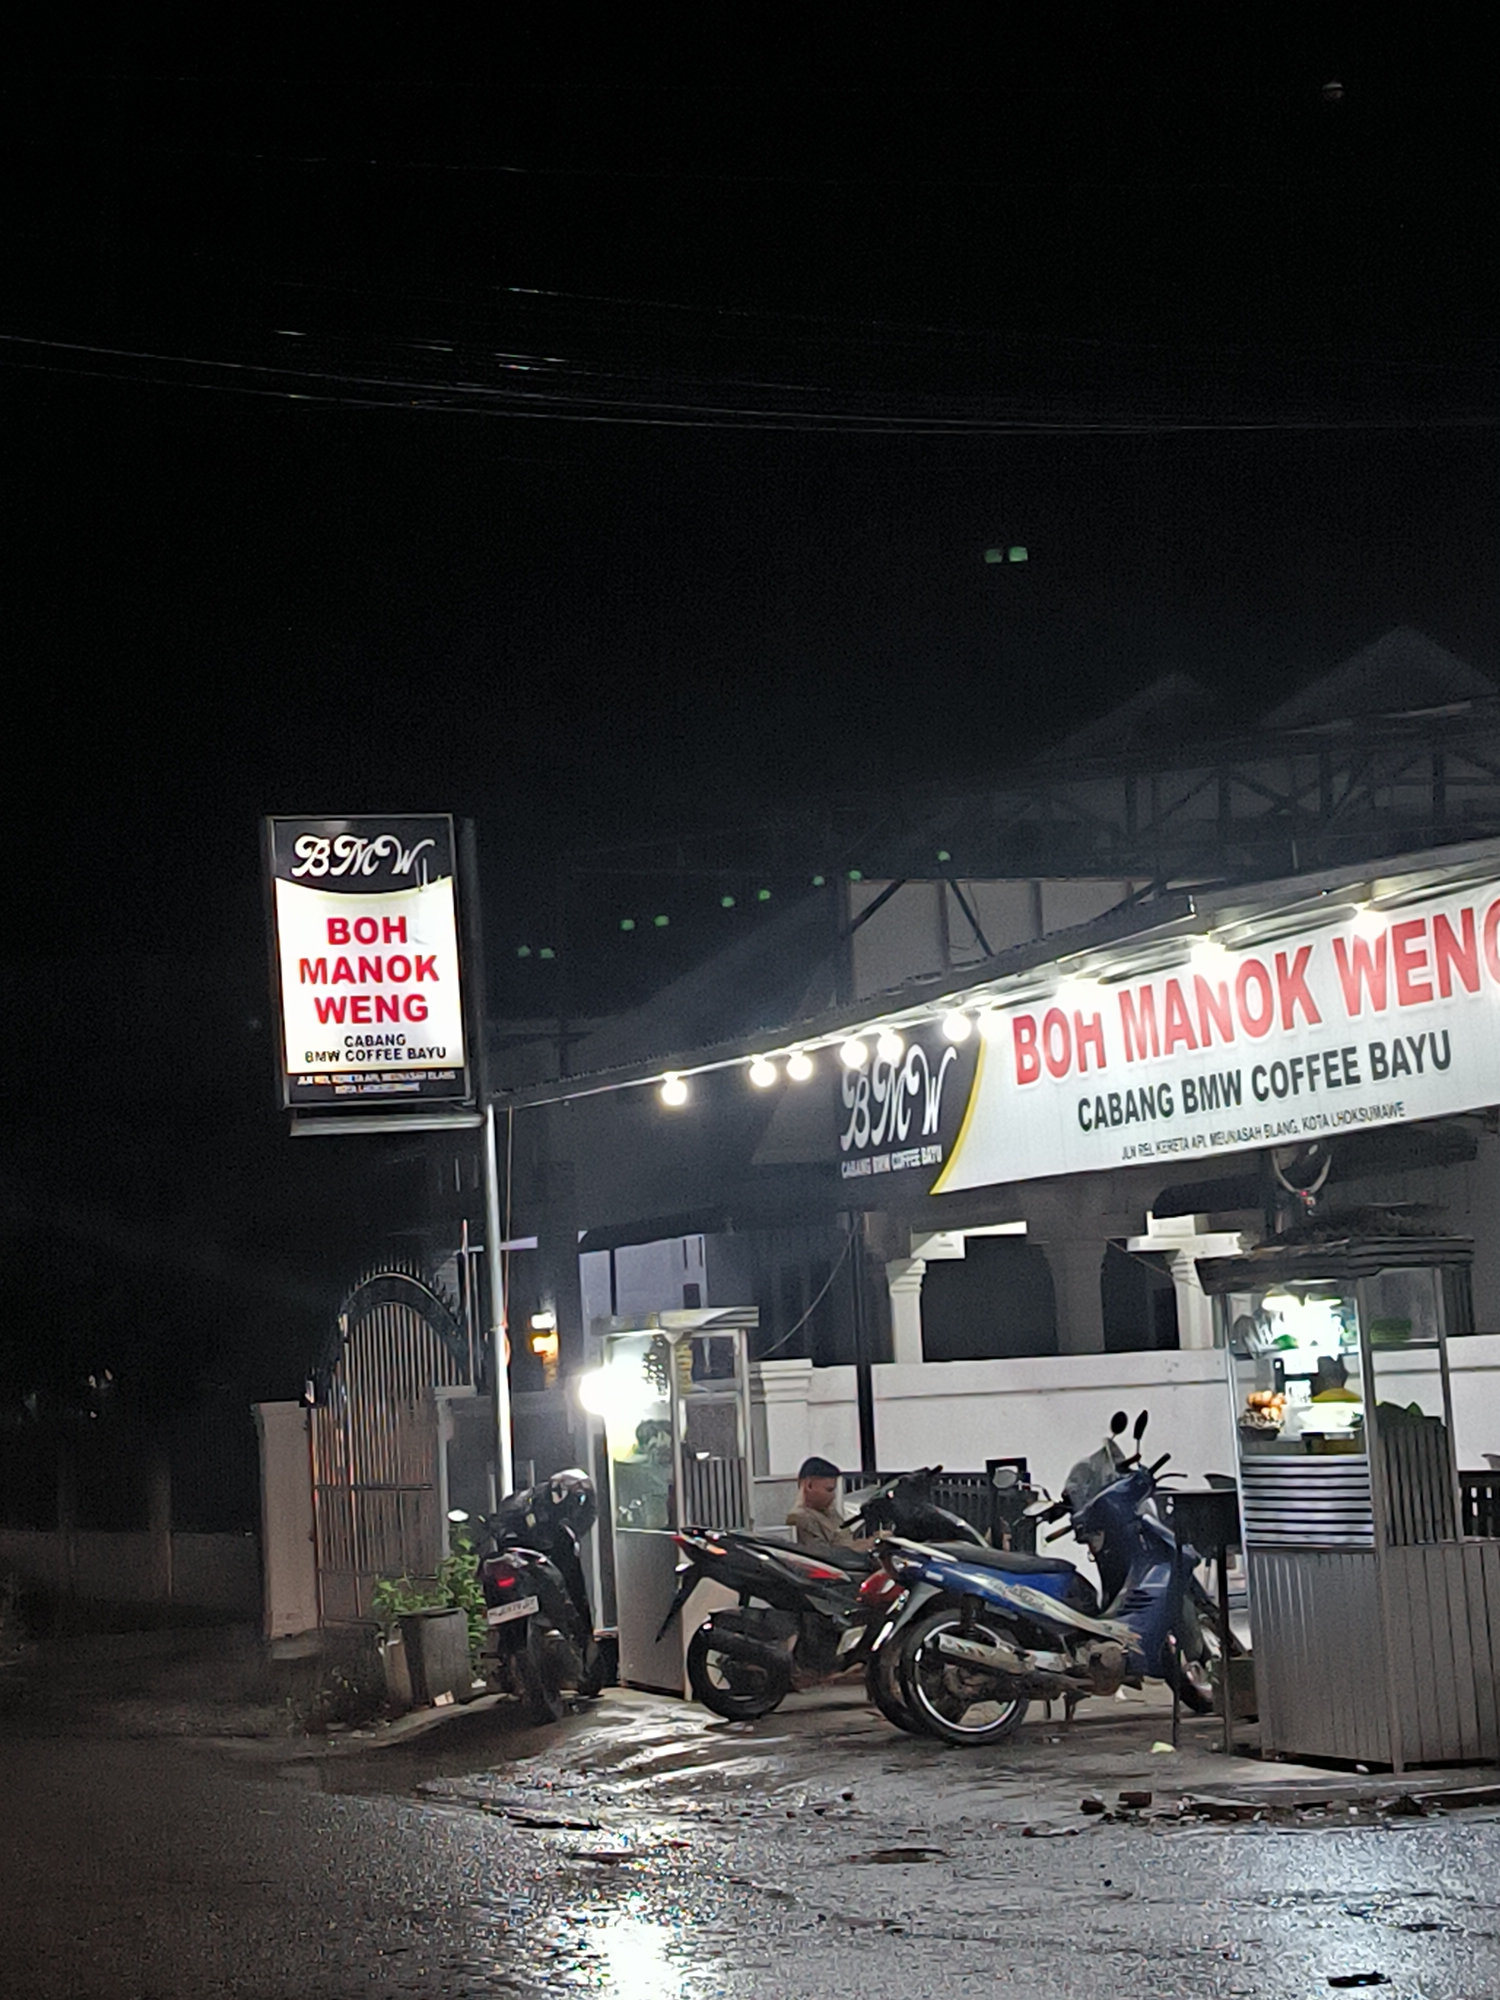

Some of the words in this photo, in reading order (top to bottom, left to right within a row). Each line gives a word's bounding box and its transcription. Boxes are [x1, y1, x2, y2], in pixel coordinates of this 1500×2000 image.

[292, 835, 435, 876] BMW
[327, 916, 408, 945] BOH
[299, 955, 440, 984] MANOK
[314, 994, 429, 1024] WENG
[1013, 1007, 1106, 1085] BOH
[1118, 945, 1323, 1062] MANOK
[305, 1049, 340, 1063] BMW
[345, 1048, 402, 1062] COFFEE
[408, 1047, 446, 1060] BAYU
[344, 1033, 406, 1048] CABANG
[1078, 1083, 1174, 1132] CABANG
[1181, 1069, 1242, 1114] BMW
[1251, 1046, 1361, 1101] COFFEE
[1369, 1029, 1452, 1082] BAYU
[1301, 1114, 1331, 1131] KOTA
